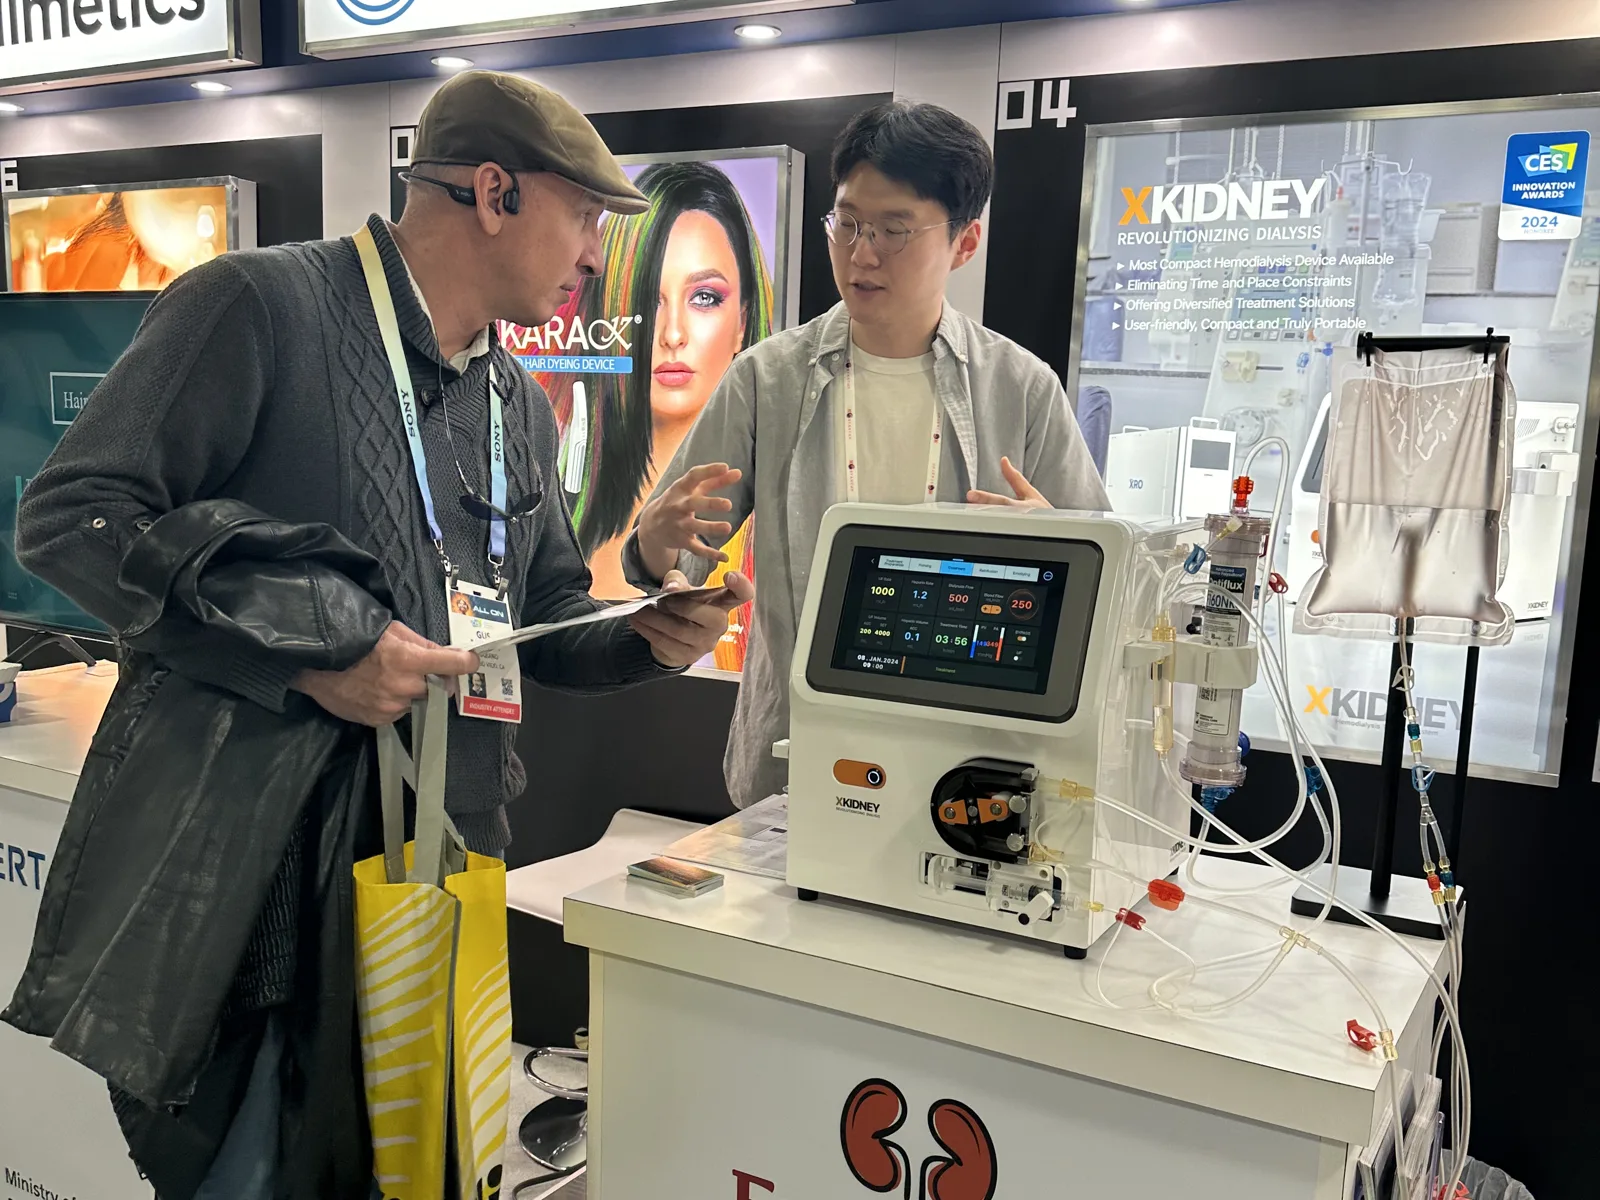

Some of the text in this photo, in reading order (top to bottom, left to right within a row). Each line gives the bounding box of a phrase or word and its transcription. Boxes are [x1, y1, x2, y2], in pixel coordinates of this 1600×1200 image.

[997, 79, 1077, 130] 04
[1525, 154, 1564, 172] CES
[1512, 181, 1576, 191] INNOVATION
[1118, 178, 1327, 225] XKIDNEY
[1521, 190, 1564, 200] AWARDS
[1521, 216, 1558, 228] 2024
[1117, 226, 1322, 245] REVOLUTIONIZING DIALYSIS
[1129, 252, 1395, 271] Most Compact Hemodialysis Device Available
[1127, 275, 1353, 291] Eliminating Time and Place Constraints
[1126, 296, 1355, 312] Offering Diversified Treatment Solutions
[1124, 316, 1367, 332] User-friendly, Compact and Truly Portable
[525, 359, 547, 369] HAIR
[547, 358, 581, 370] DYEING
[582, 359, 615, 370] DEVICE
[400, 389, 416, 438] SONY
[494, 420, 502, 462] SONY
[870, 586, 895, 596] 1000
[913, 590, 928, 599] 1.2
[948, 593, 969, 603] 500
[1011, 599, 1032, 610] 250
[904, 631, 920, 641] 0.1
[935, 634, 968, 646] 03:56
[1304, 685, 1462, 730] XKIDEY
[836, 796, 880, 813] XKIDNEY
[0, 842, 46, 890] RT
